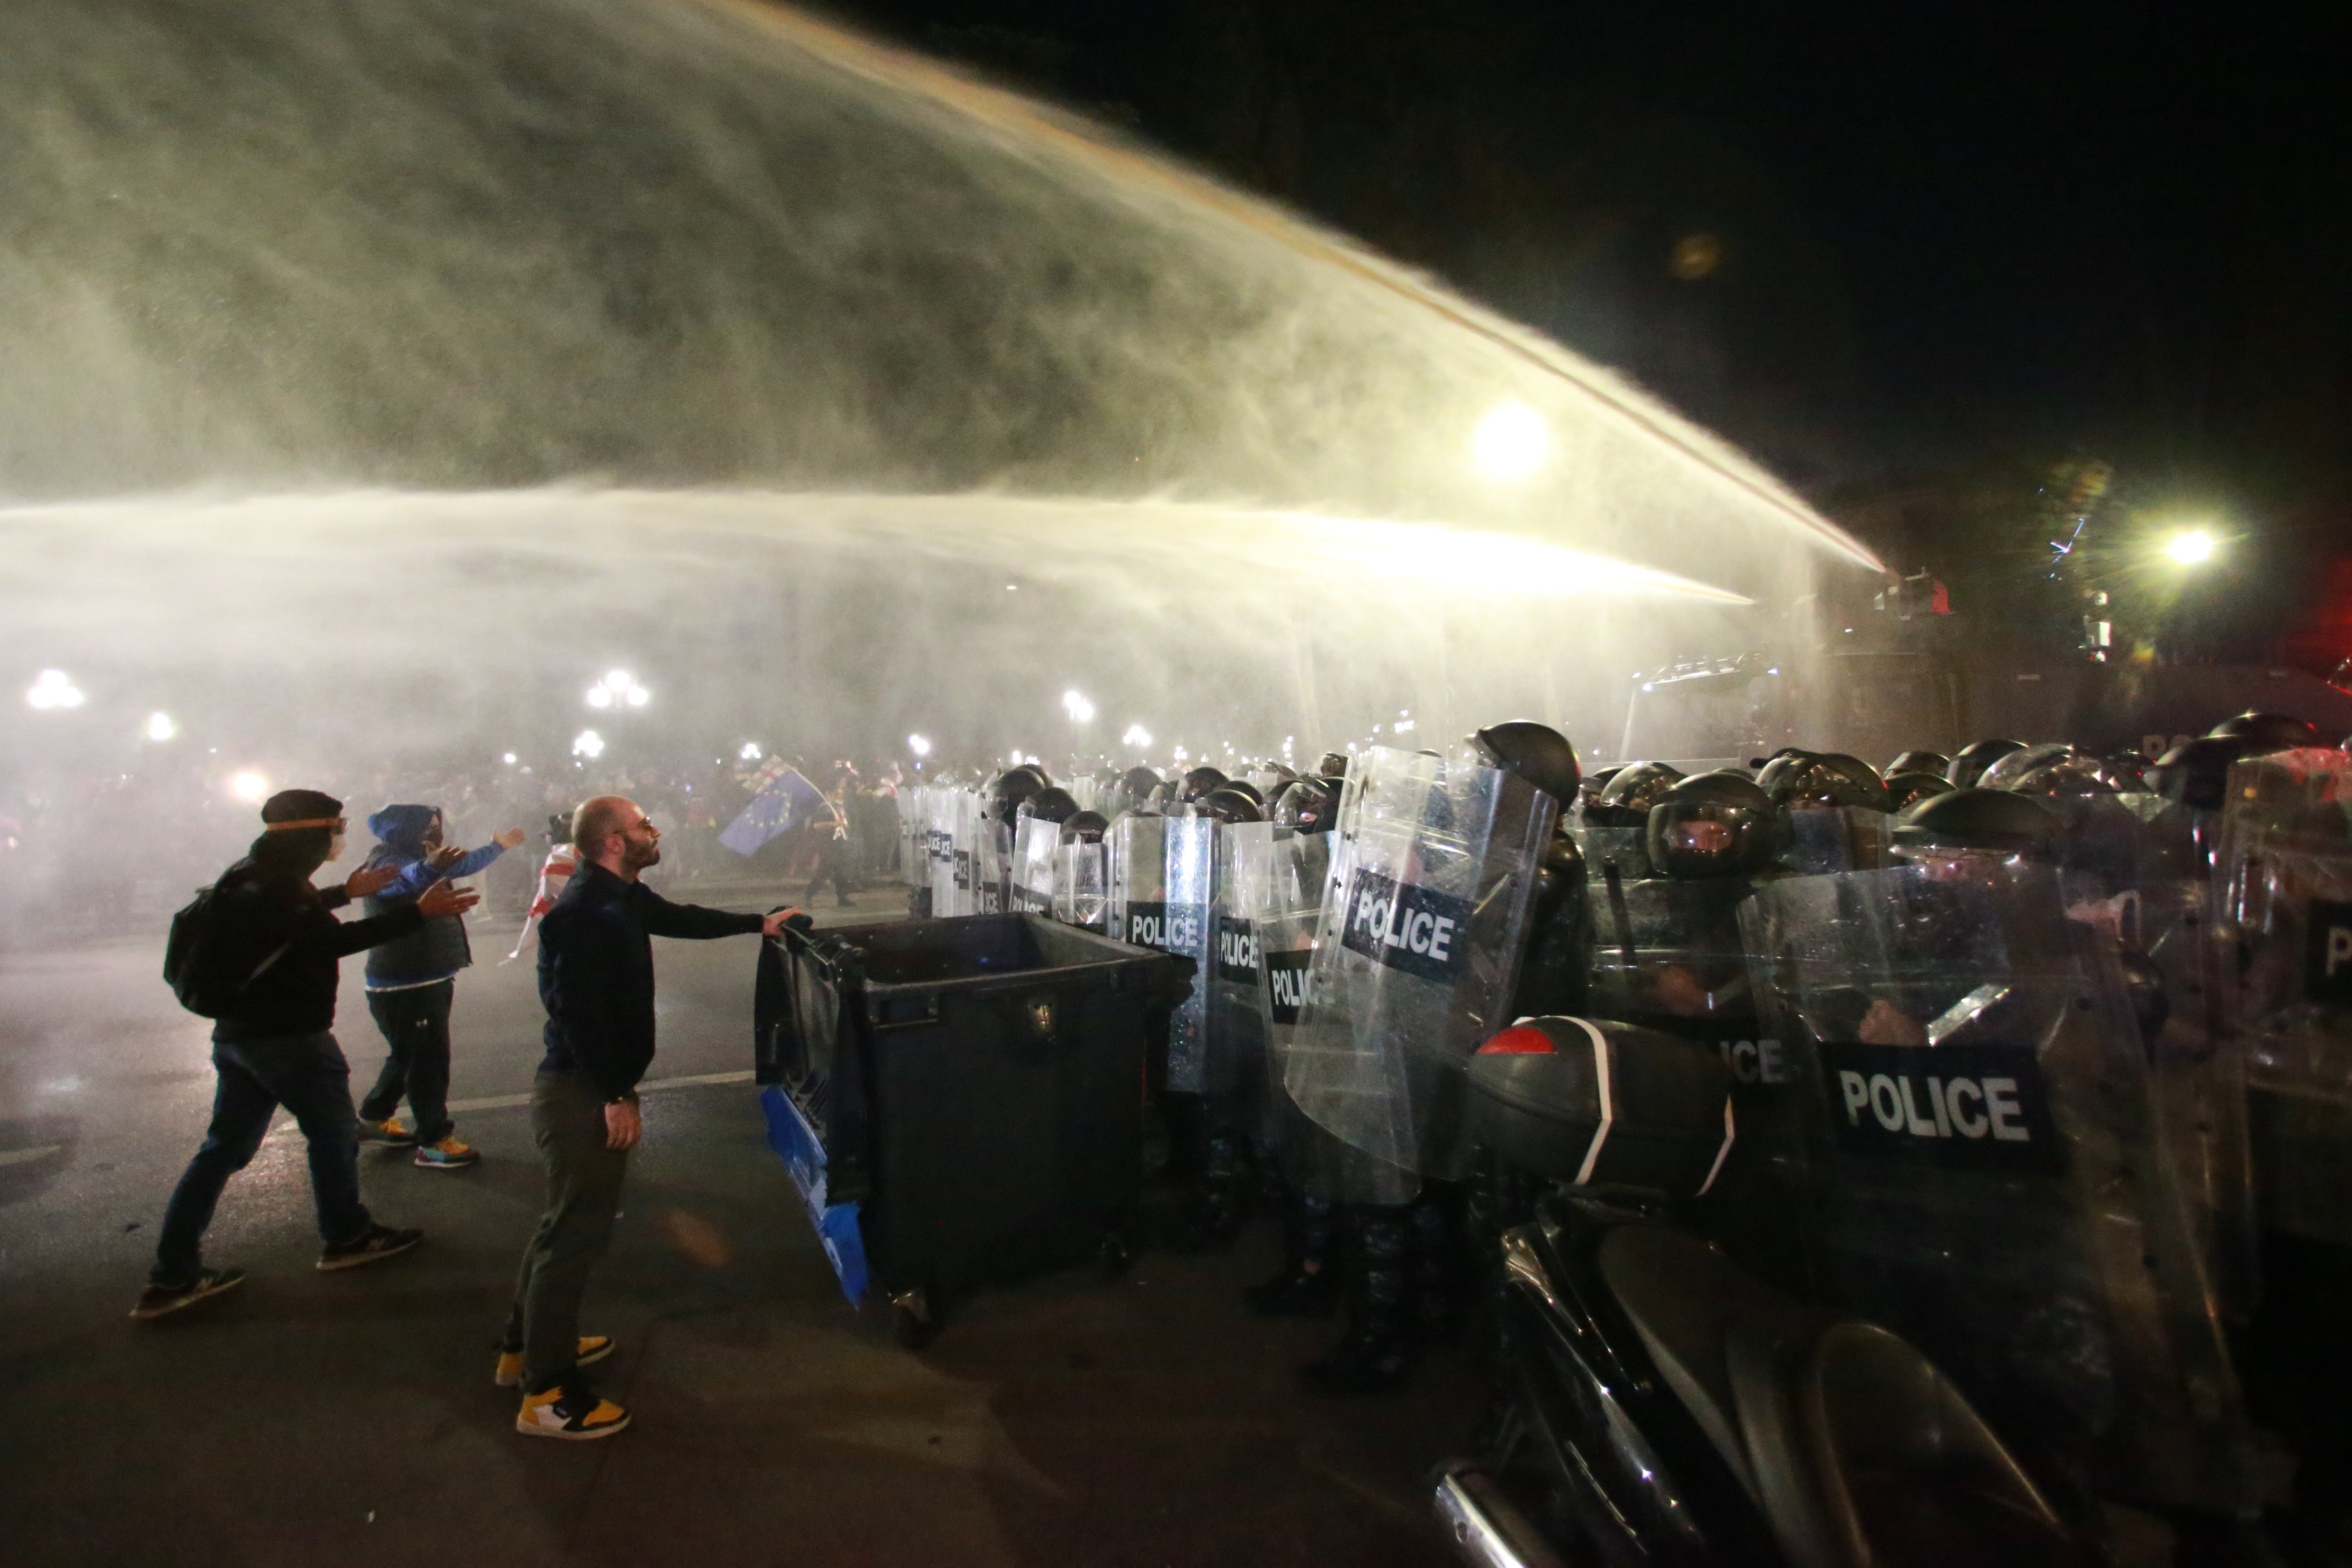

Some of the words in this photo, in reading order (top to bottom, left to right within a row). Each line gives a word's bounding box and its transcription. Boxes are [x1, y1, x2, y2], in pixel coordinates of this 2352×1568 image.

[1132, 915, 1198, 947] POLICE
[1221, 931, 1259, 969] POLICE
[1354, 888, 1455, 962] POLICE
[1839, 1070, 2031, 1142] POLICE
